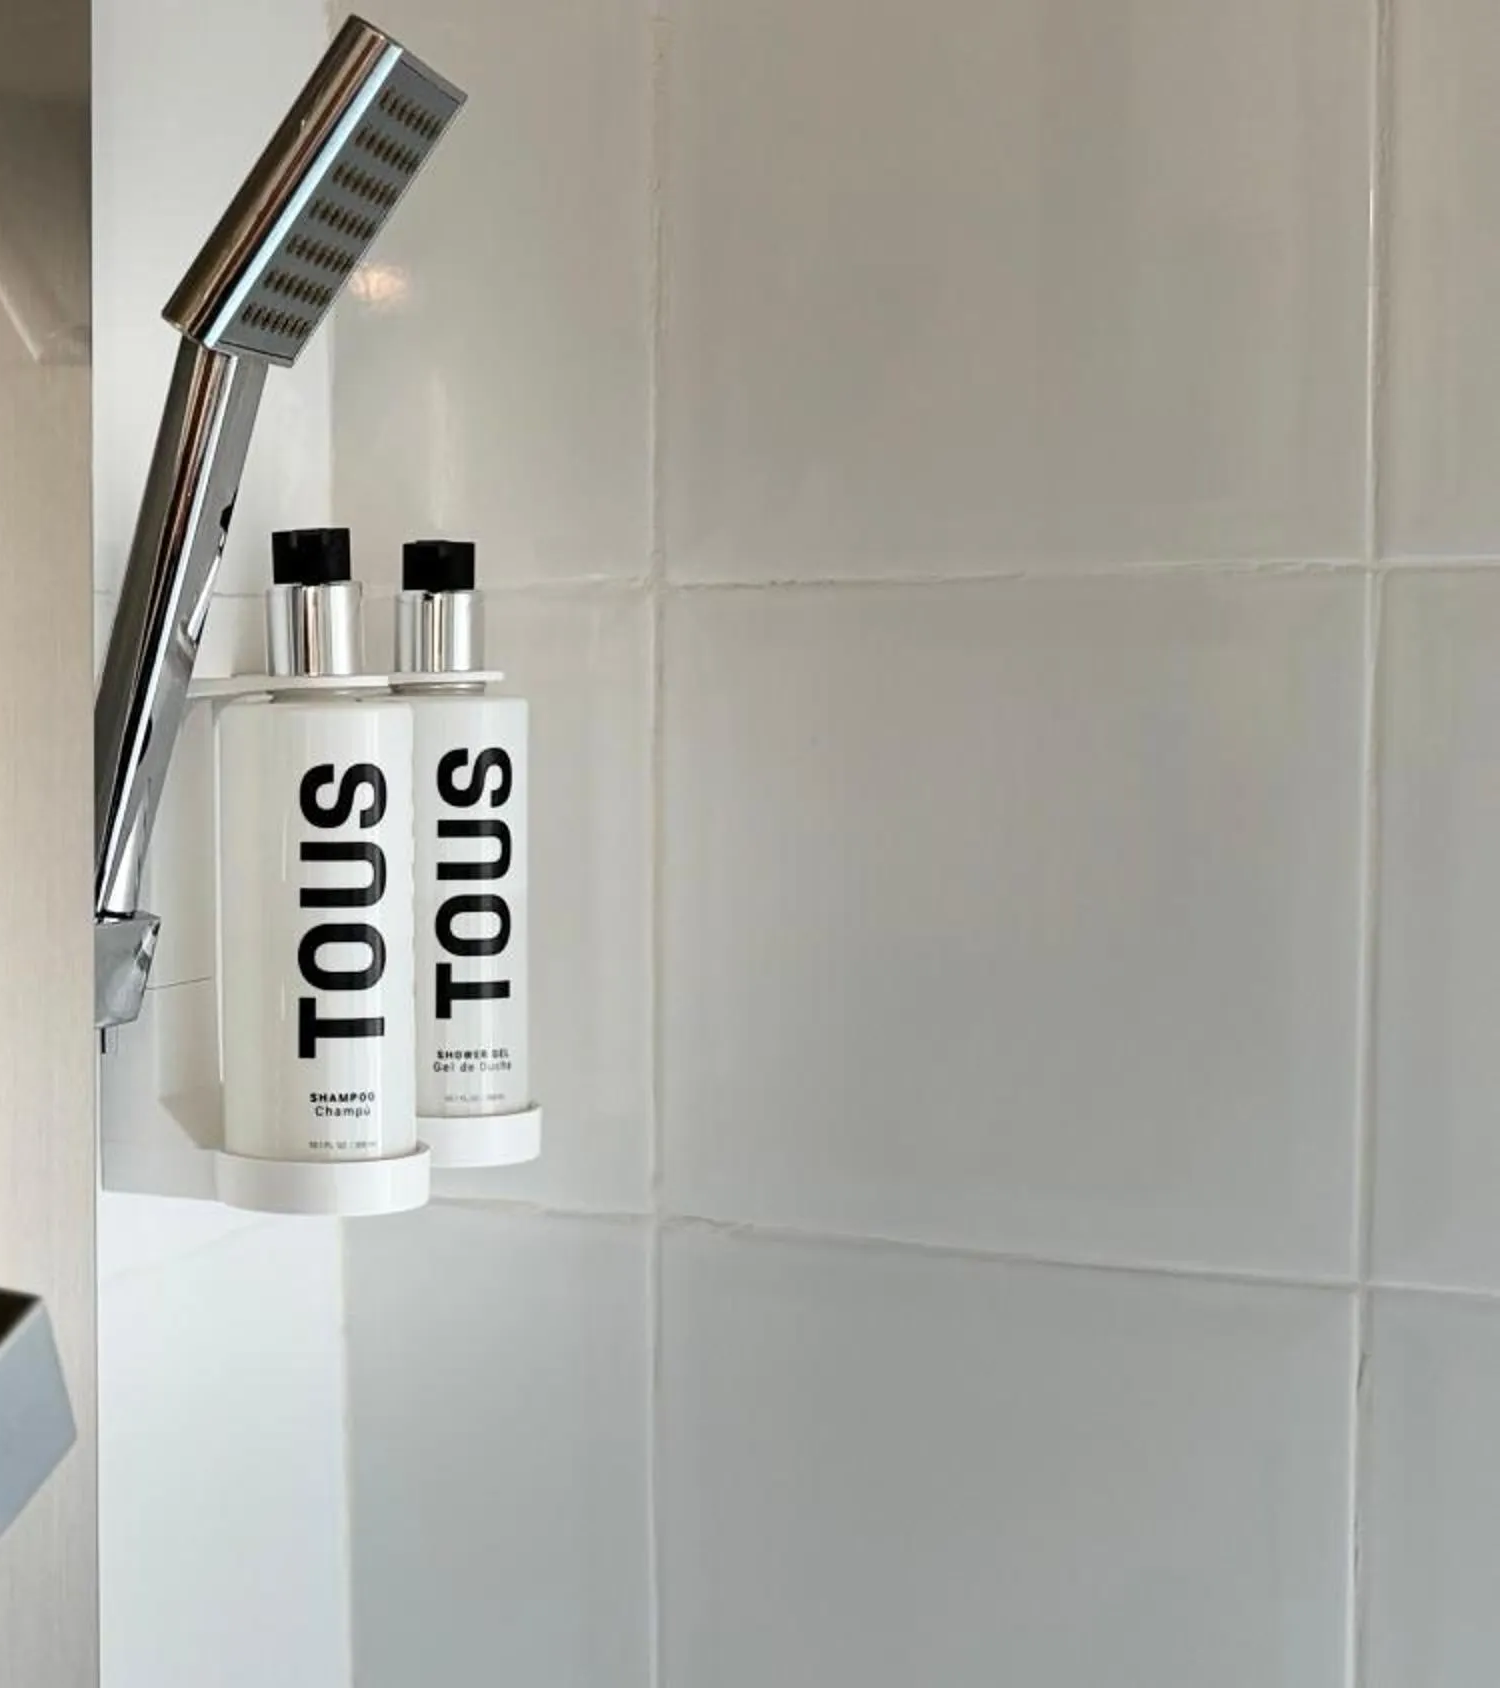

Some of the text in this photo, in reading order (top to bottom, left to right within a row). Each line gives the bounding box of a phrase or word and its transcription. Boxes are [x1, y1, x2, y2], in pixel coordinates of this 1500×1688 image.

[435, 748, 513, 1019] TOUS
[298, 763, 387, 1059] TOUS
[436, 1048, 509, 1060] SHOWER GEL
[433, 1061, 455, 1073] Gel
[460, 1061, 475, 1073] de
[309, 1092, 375, 1103] SHAMPOO
